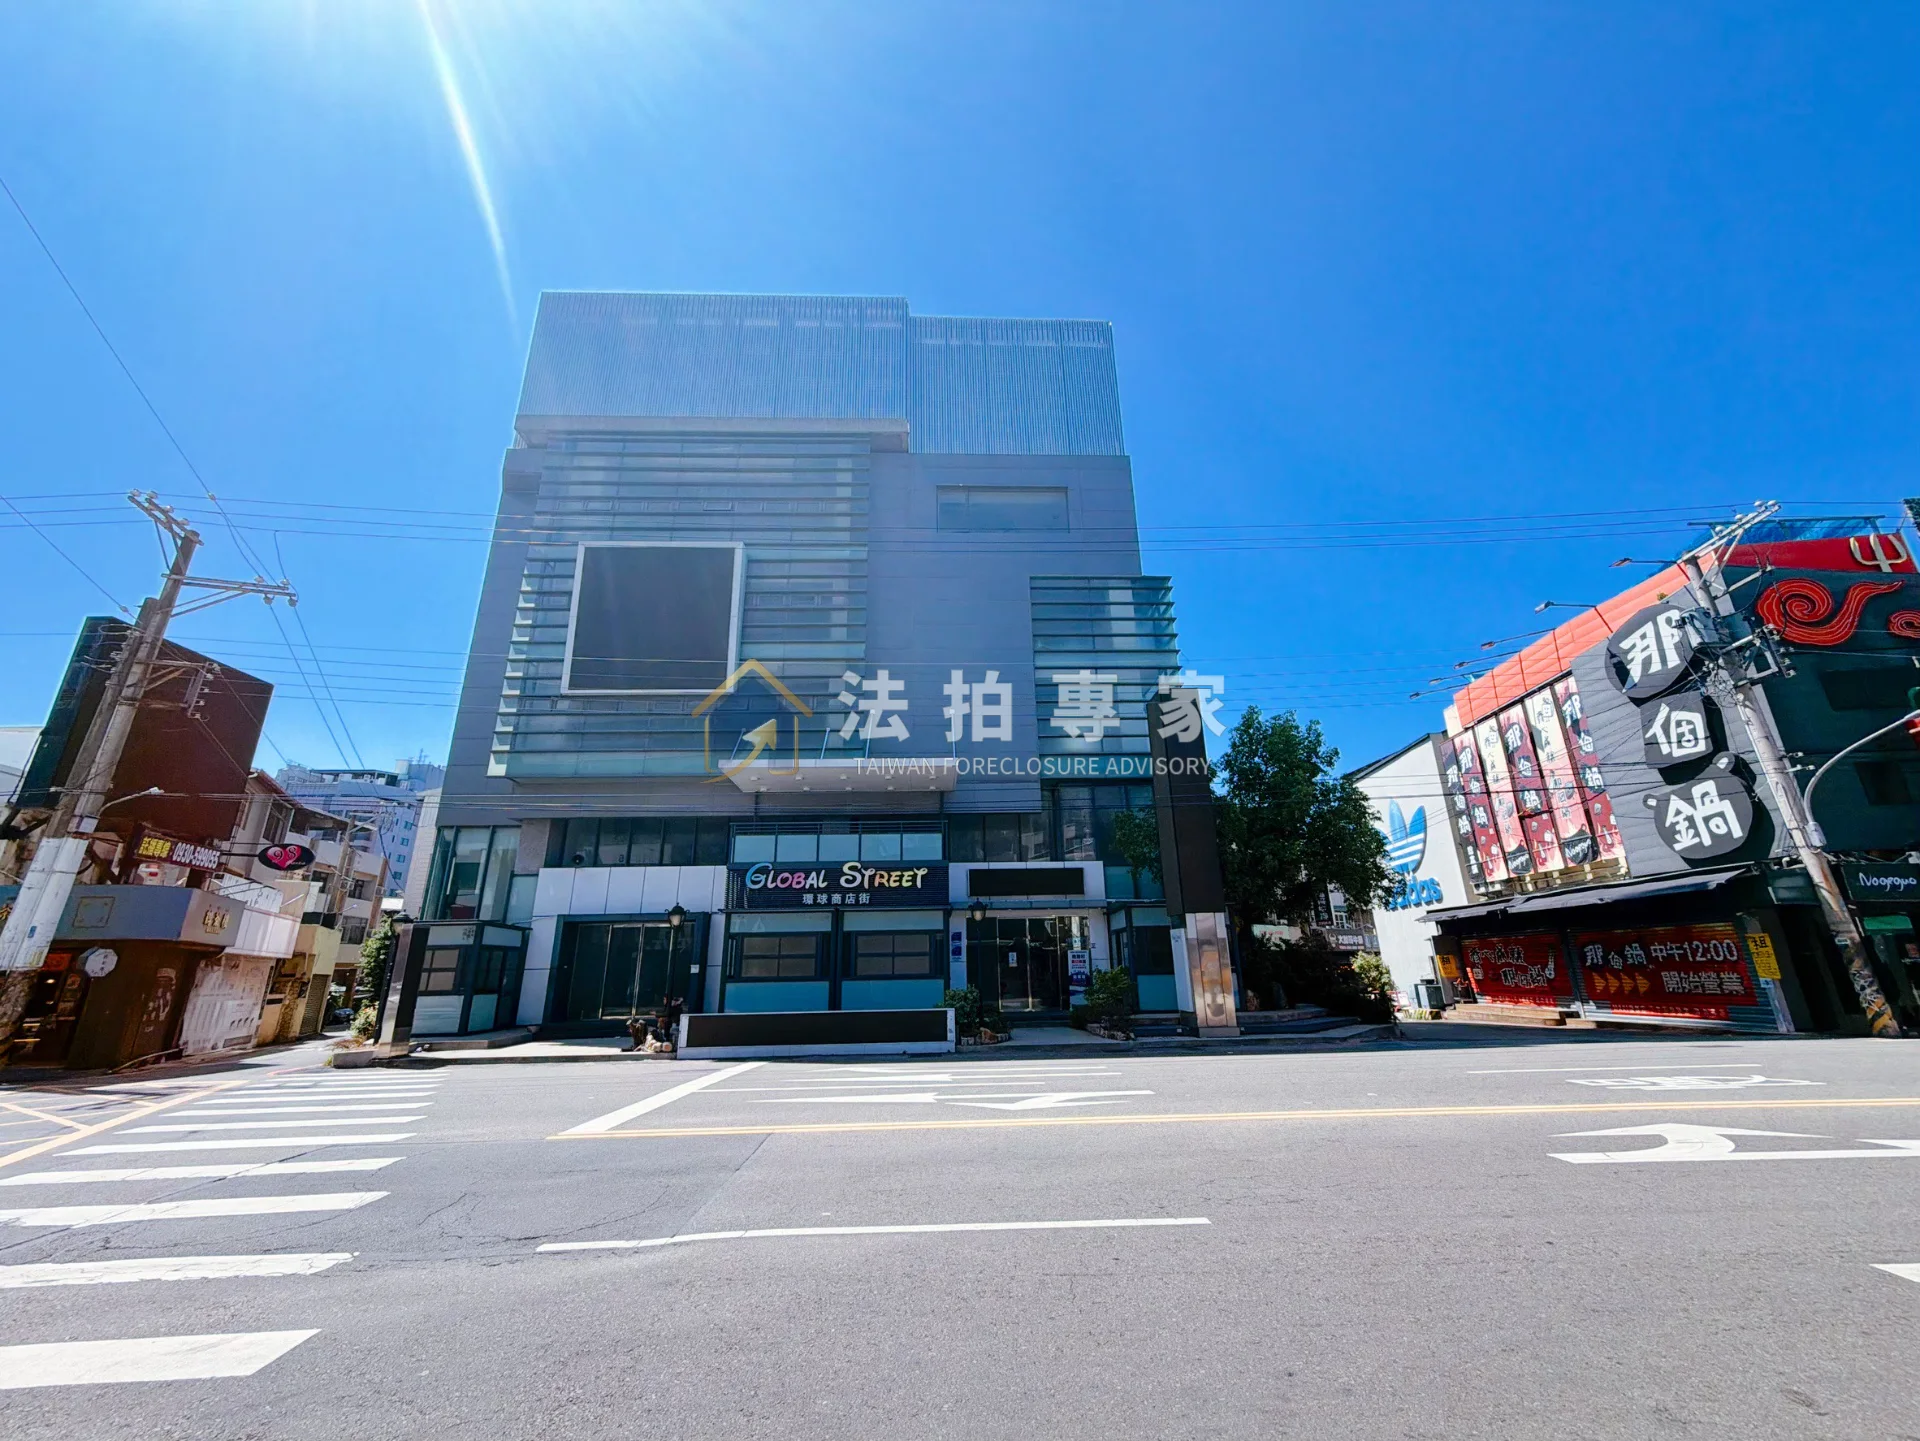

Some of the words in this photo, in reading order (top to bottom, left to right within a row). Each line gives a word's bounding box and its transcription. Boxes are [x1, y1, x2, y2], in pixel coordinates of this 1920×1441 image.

[1619, 609, 1743, 851] 那個鍋
[1505, 724, 1540, 809] 那個鍋
[745, 862, 828, 890] GLOBAL
[839, 862, 928, 889] STREET
[802, 893, 870, 905] 環球商店街
[1584, 943, 1647, 970] 那個鍋
[1660, 970, 1746, 995] 開始營業
